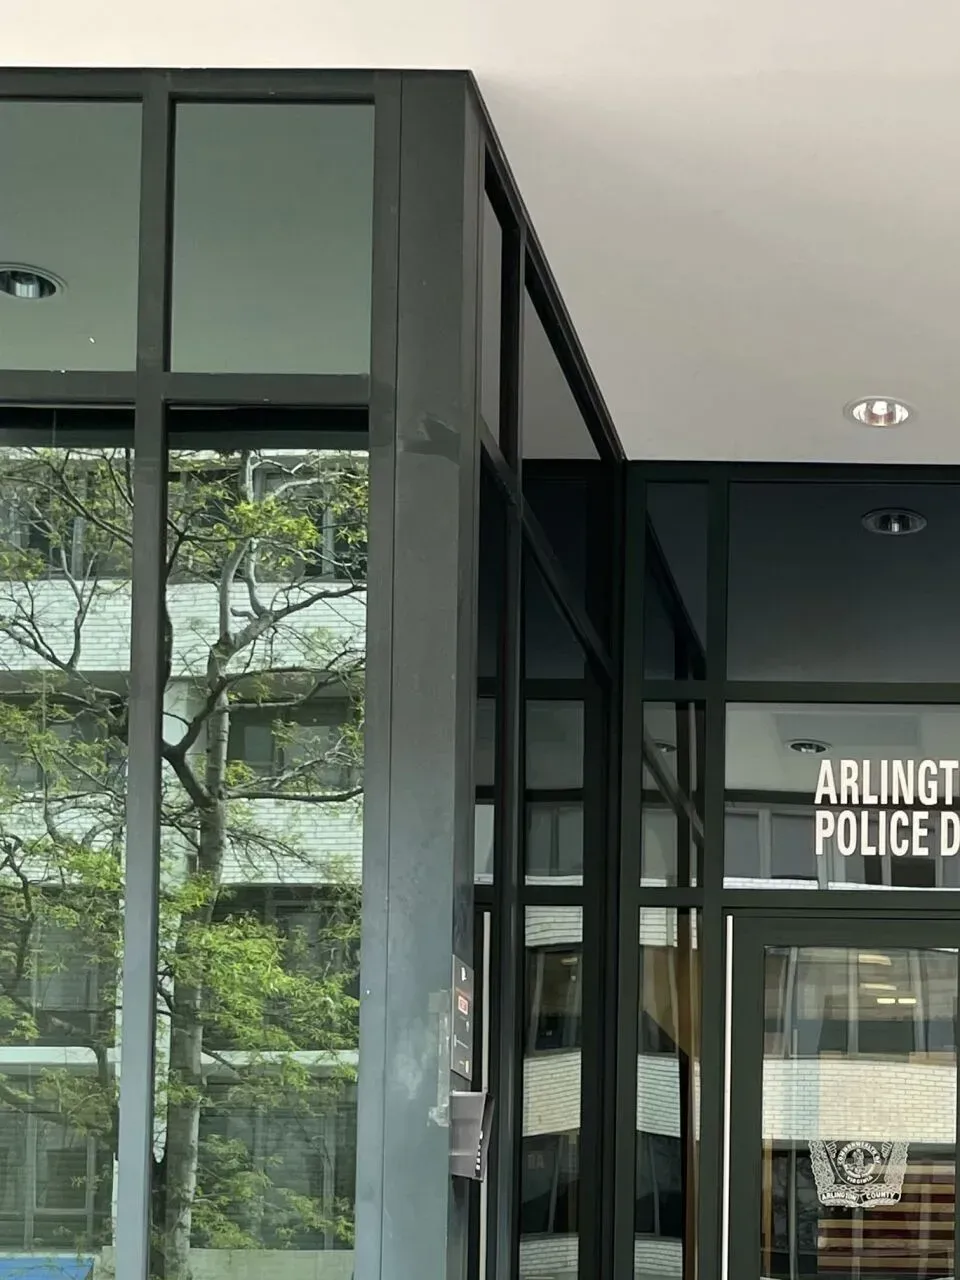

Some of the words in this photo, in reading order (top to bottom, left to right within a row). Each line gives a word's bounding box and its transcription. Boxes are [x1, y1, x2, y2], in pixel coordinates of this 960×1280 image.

[815, 810, 929, 856] POLICE
[846, 1175, 874, 1185] VIRGINIA
[821, 1192, 857, 1201] ARLINGTON
[866, 1192, 895, 1200] COUNTY
